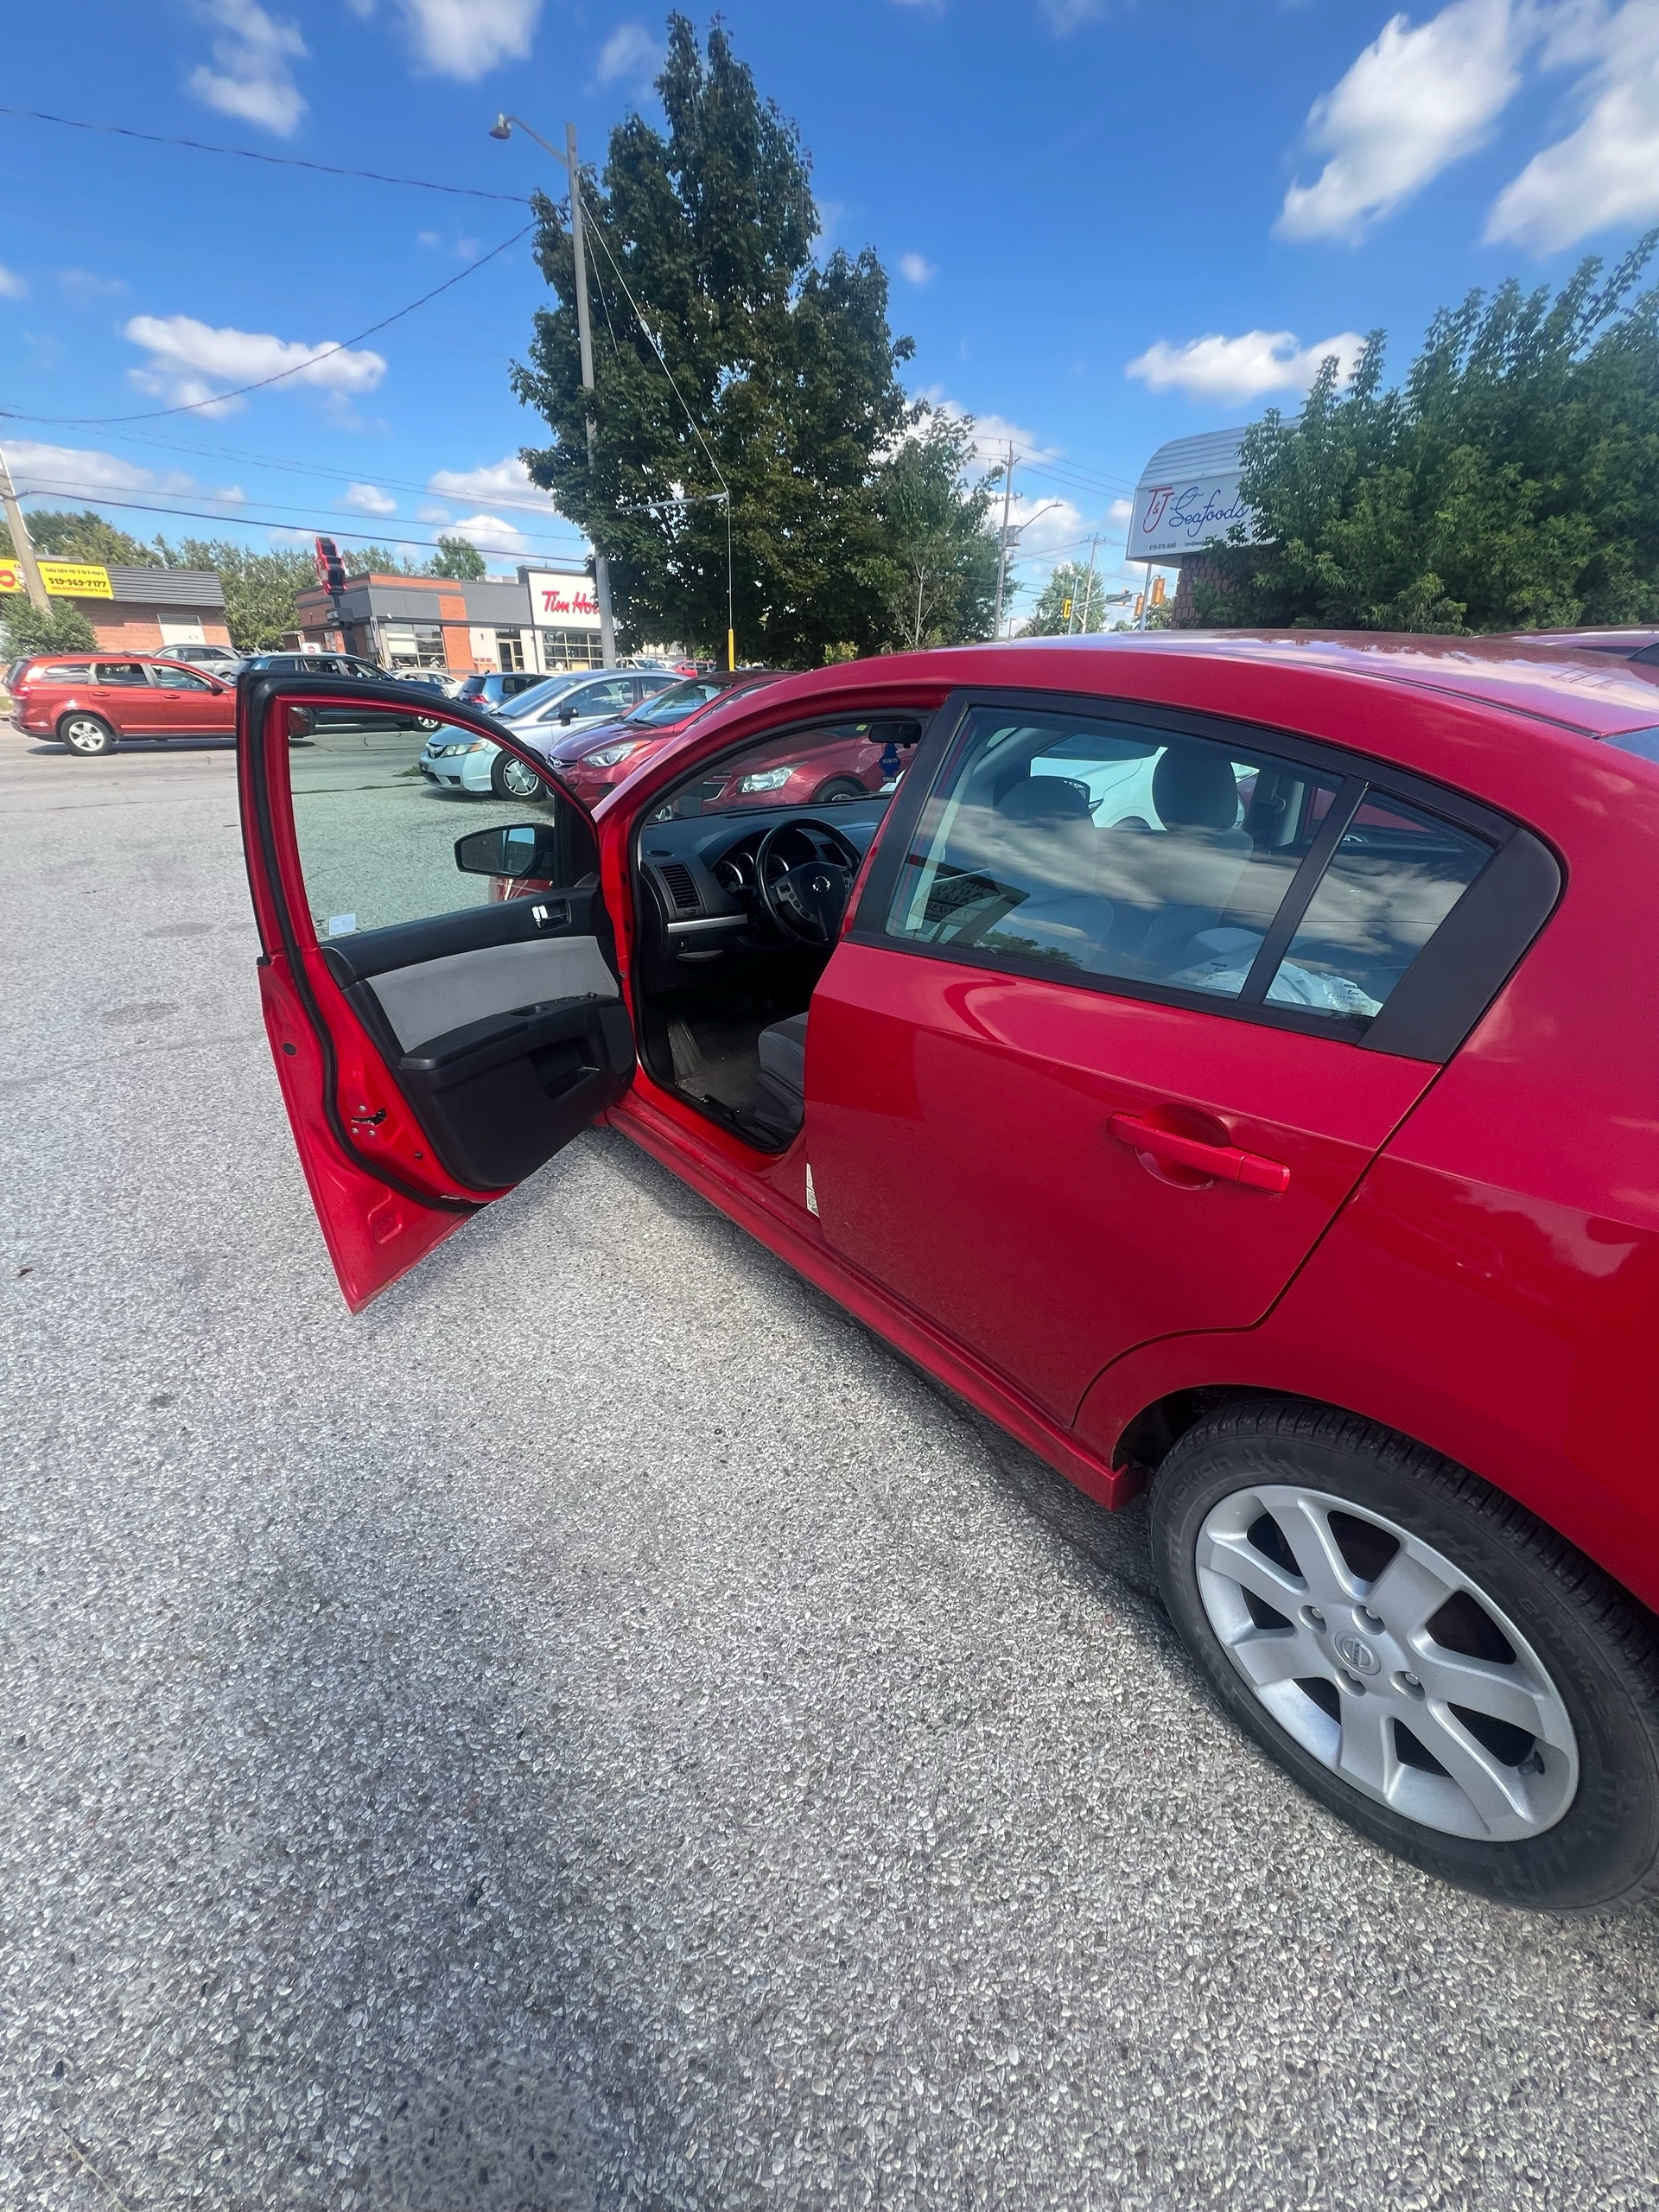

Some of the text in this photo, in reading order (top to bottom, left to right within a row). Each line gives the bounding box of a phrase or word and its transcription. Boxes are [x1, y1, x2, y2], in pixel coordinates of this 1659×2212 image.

[1168, 486, 1249, 537] Seafoods
[48, 576, 107, 588] 519-569-7177
[541, 590, 570, 614] Tim
